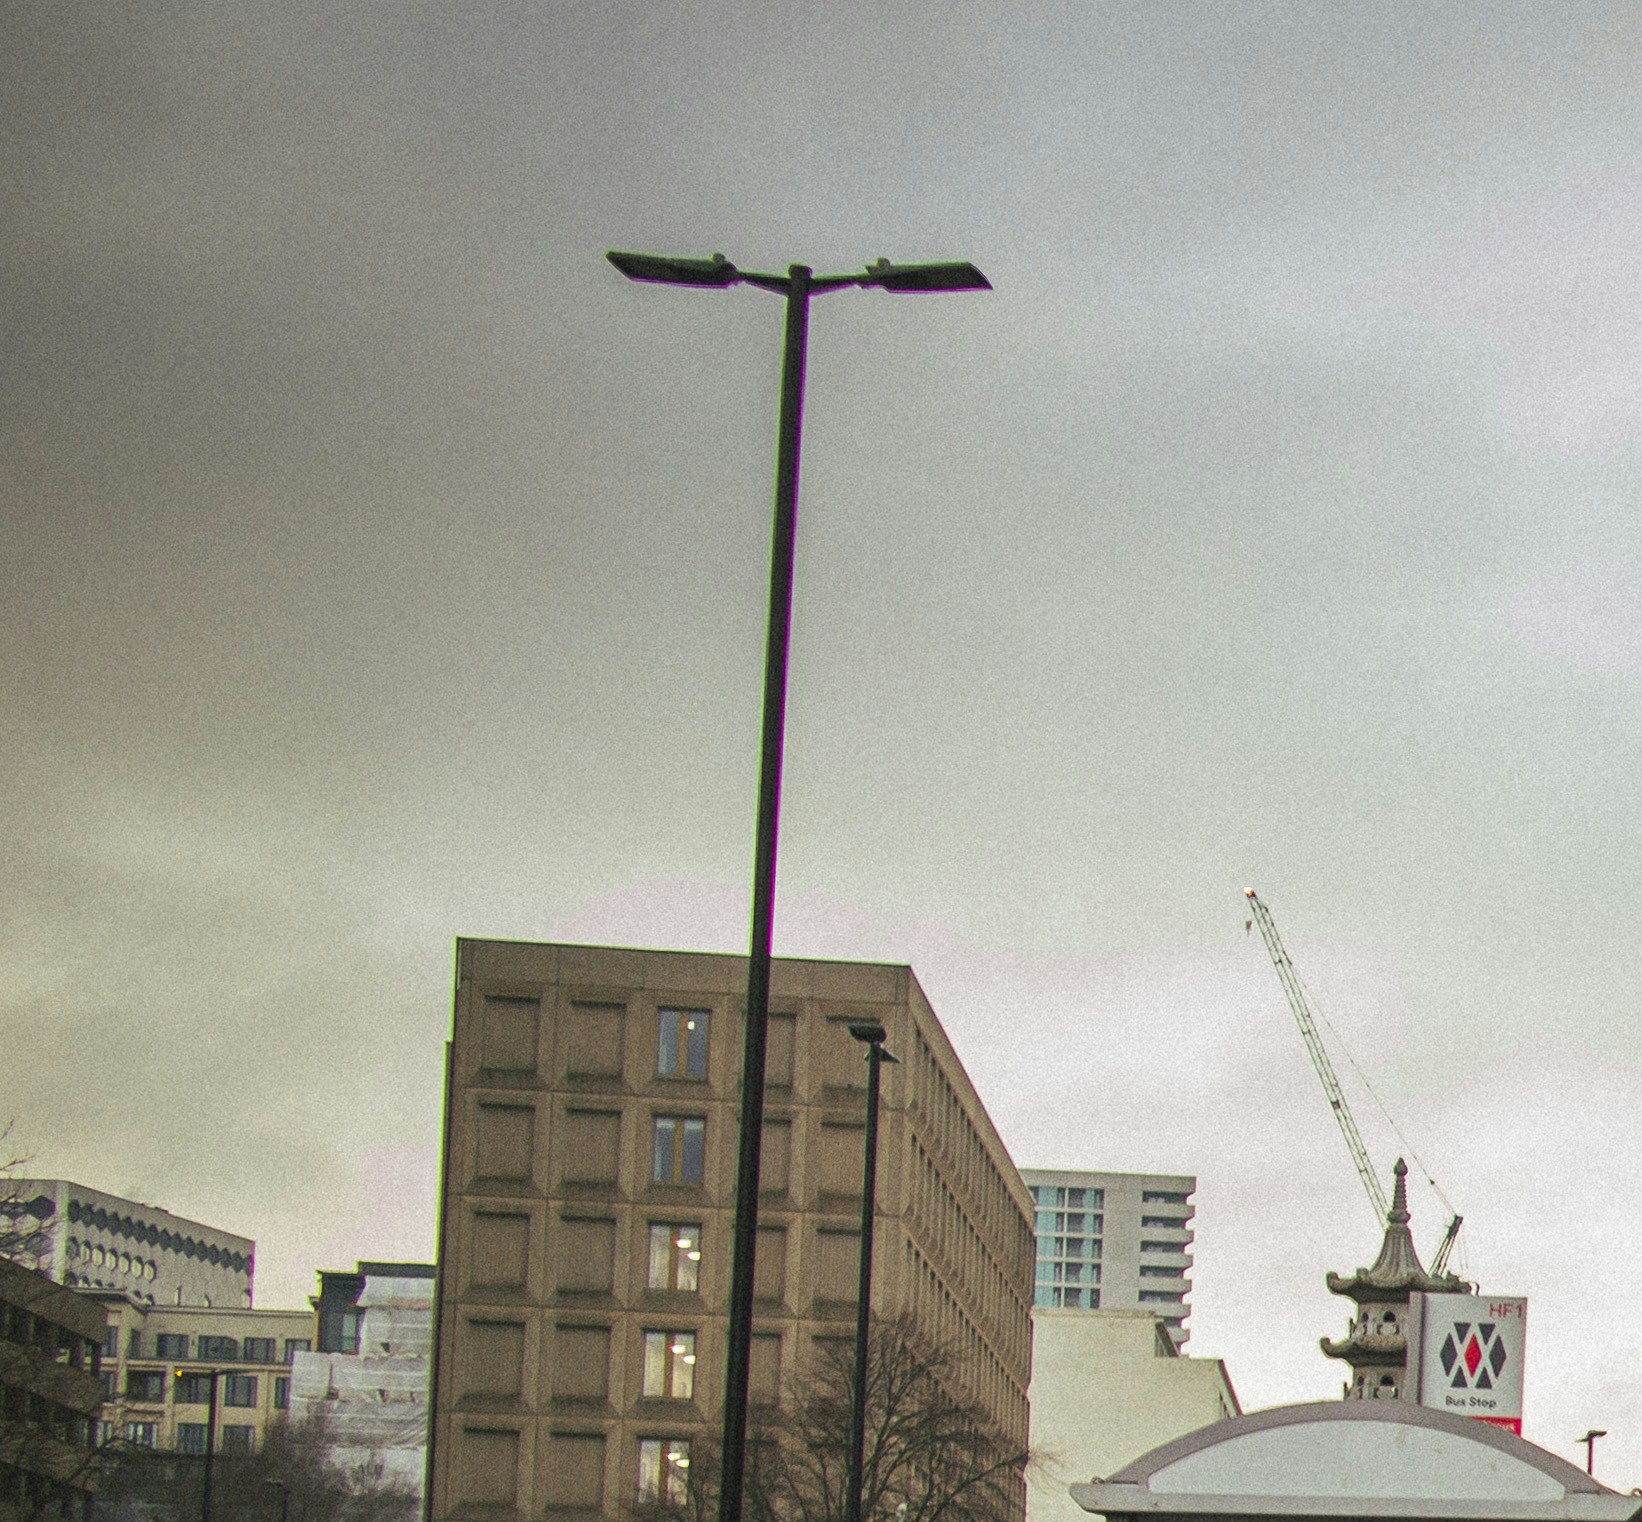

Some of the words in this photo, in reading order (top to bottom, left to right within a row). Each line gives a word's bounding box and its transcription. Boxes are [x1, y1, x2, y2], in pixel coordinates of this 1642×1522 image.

[1489, 1303, 1522, 1318] HF1
[1445, 1395, 1466, 1406] Bus
[1469, 1396, 1497, 1408] Stop
